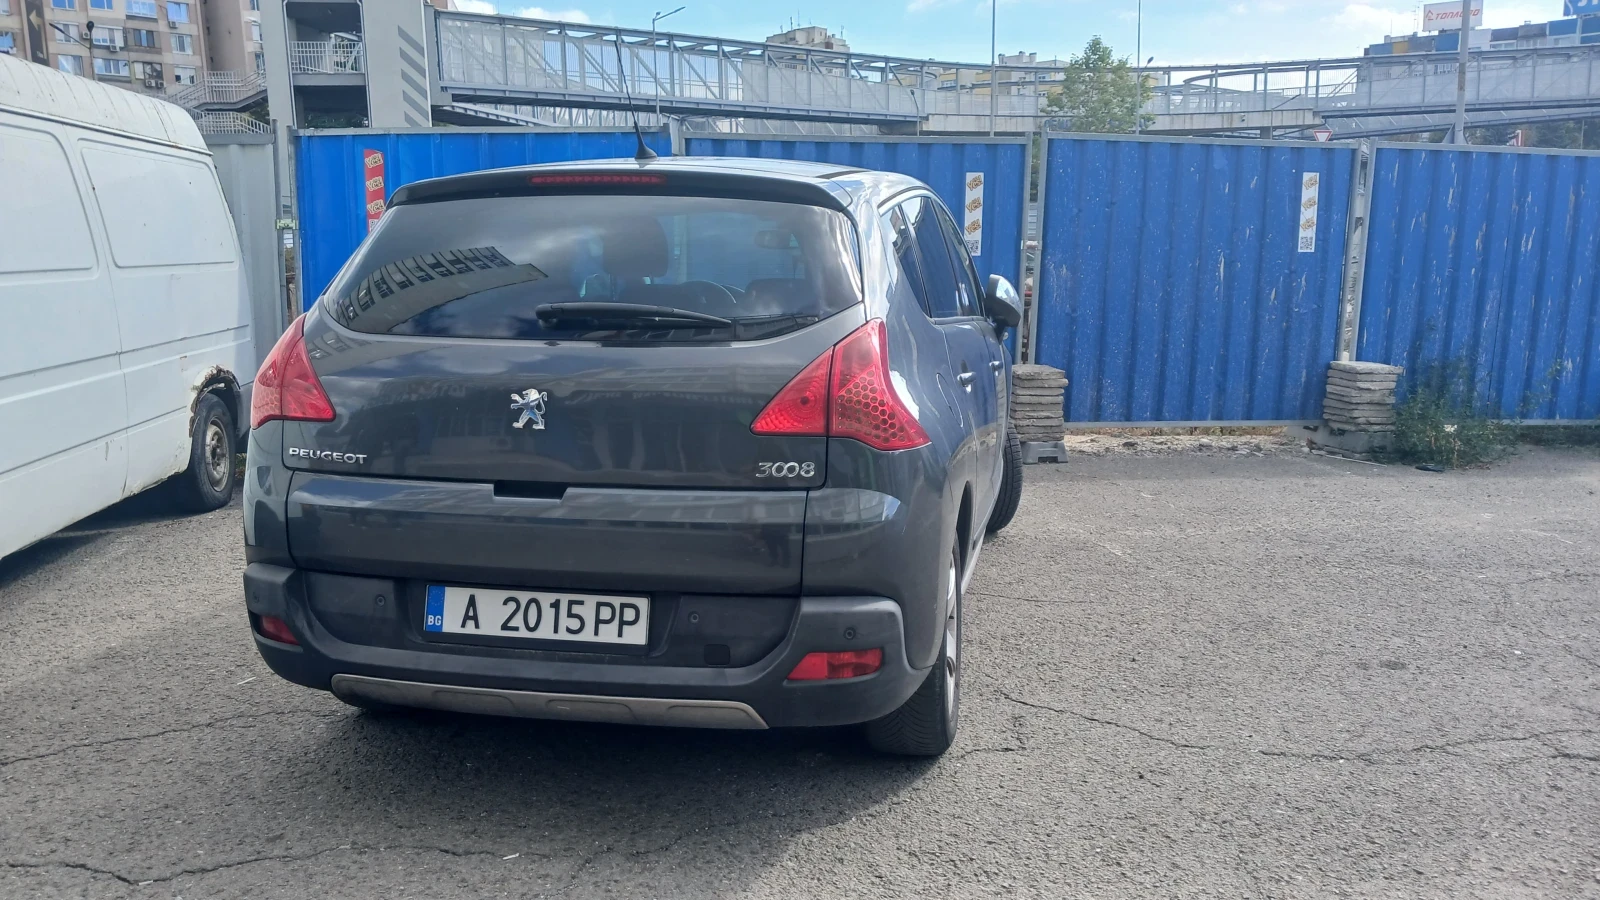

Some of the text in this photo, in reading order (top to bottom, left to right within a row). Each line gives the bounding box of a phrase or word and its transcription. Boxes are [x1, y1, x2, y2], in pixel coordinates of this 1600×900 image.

[289, 447, 367, 465] PEUGEOT
[755, 461, 815, 478] 3008
[427, 615, 442, 626] BG
